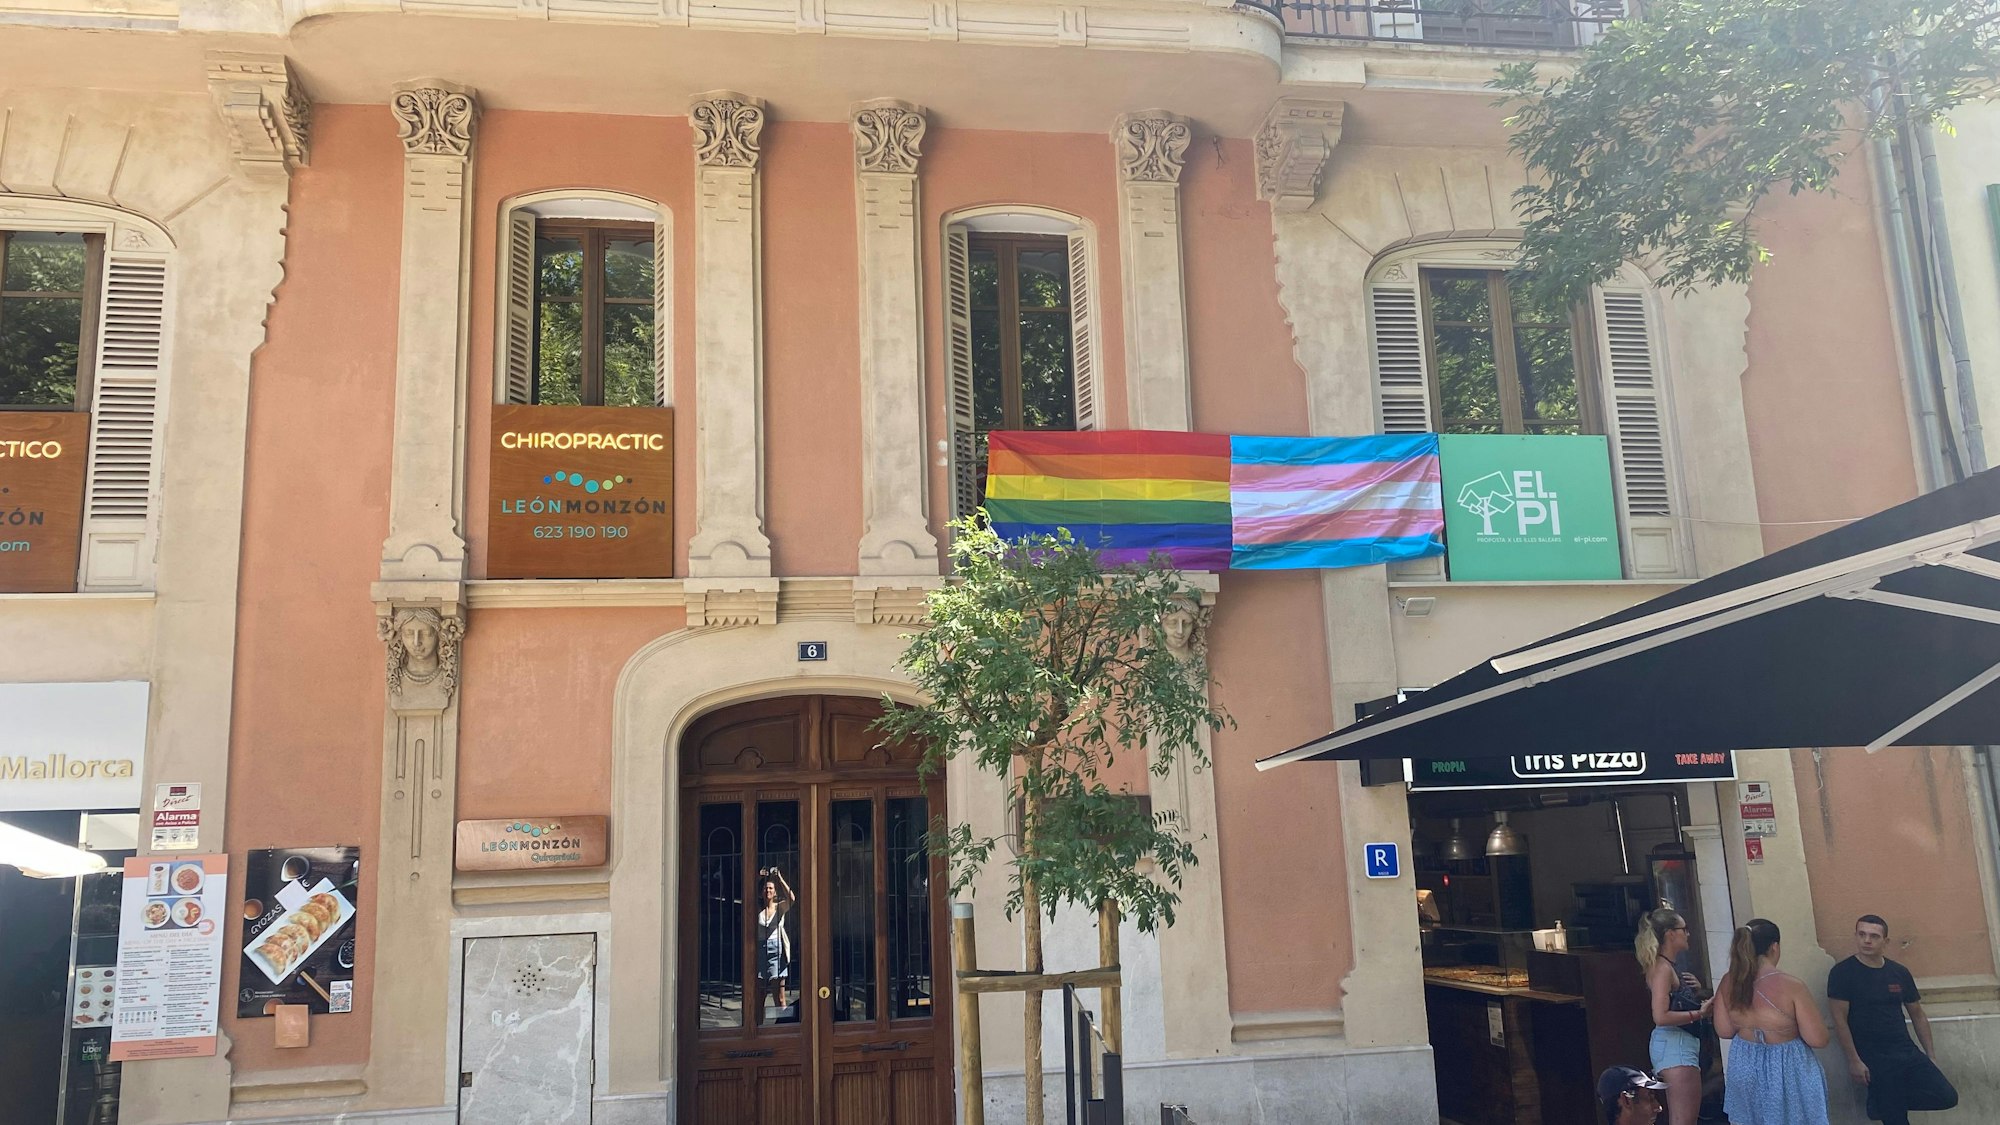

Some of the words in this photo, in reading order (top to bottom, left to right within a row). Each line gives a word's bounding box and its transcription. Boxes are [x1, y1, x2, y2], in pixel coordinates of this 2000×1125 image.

[500, 432, 664, 450] CHIROPRACTIC
[1516, 500, 1561, 535] PI
[533, 526, 564, 539] 623
[568, 526, 596, 539] 190
[601, 526, 629, 539] 190
[1574, 536, 1608, 544] el-pi.com
[807, 644, 818, 658] 6
[1674, 753, 1699, 765] TAKE
[1700, 752, 1726, 765] AWAY
[0, 753, 134, 780] Mallorca
[1431, 760, 1466, 773] PROPIA
[1743, 805, 1772, 813] Alarma
[156, 812, 197, 820] Alarma
[1375, 849, 1389, 866] R
[250, 904, 282, 934] GYOZAS
[82, 1045, 102, 1054] Uber
